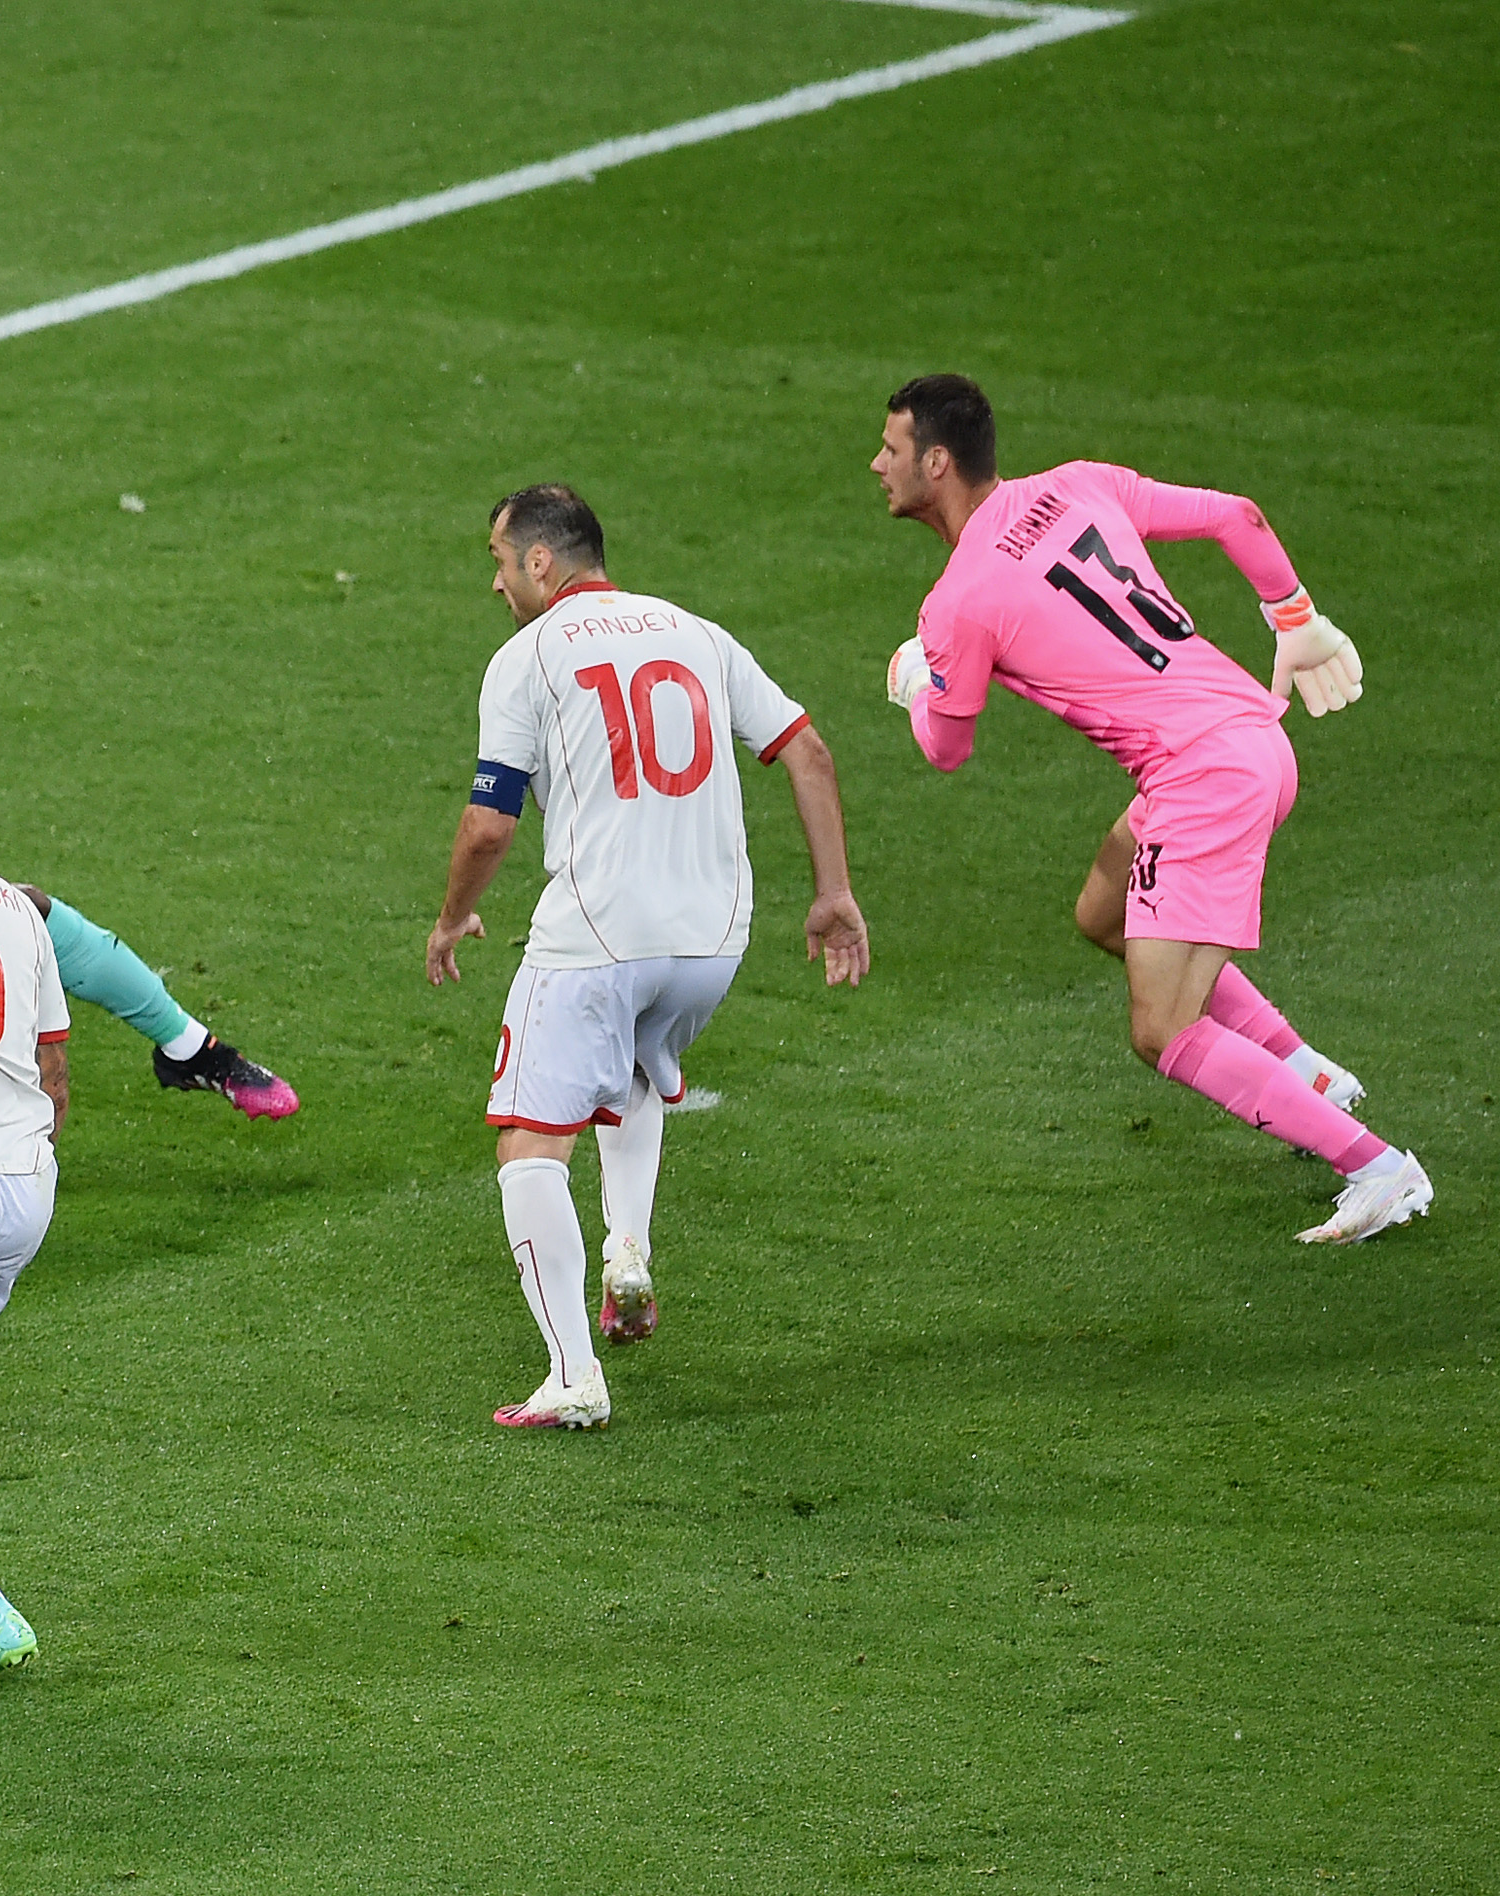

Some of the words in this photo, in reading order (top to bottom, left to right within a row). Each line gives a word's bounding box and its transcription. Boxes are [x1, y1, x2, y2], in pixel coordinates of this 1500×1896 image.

[995, 490, 1071, 561] BACHMANN
[560, 612, 678, 644] PANDEV
[1043, 522, 1195, 674] 13
[573, 659, 713, 800] 10
